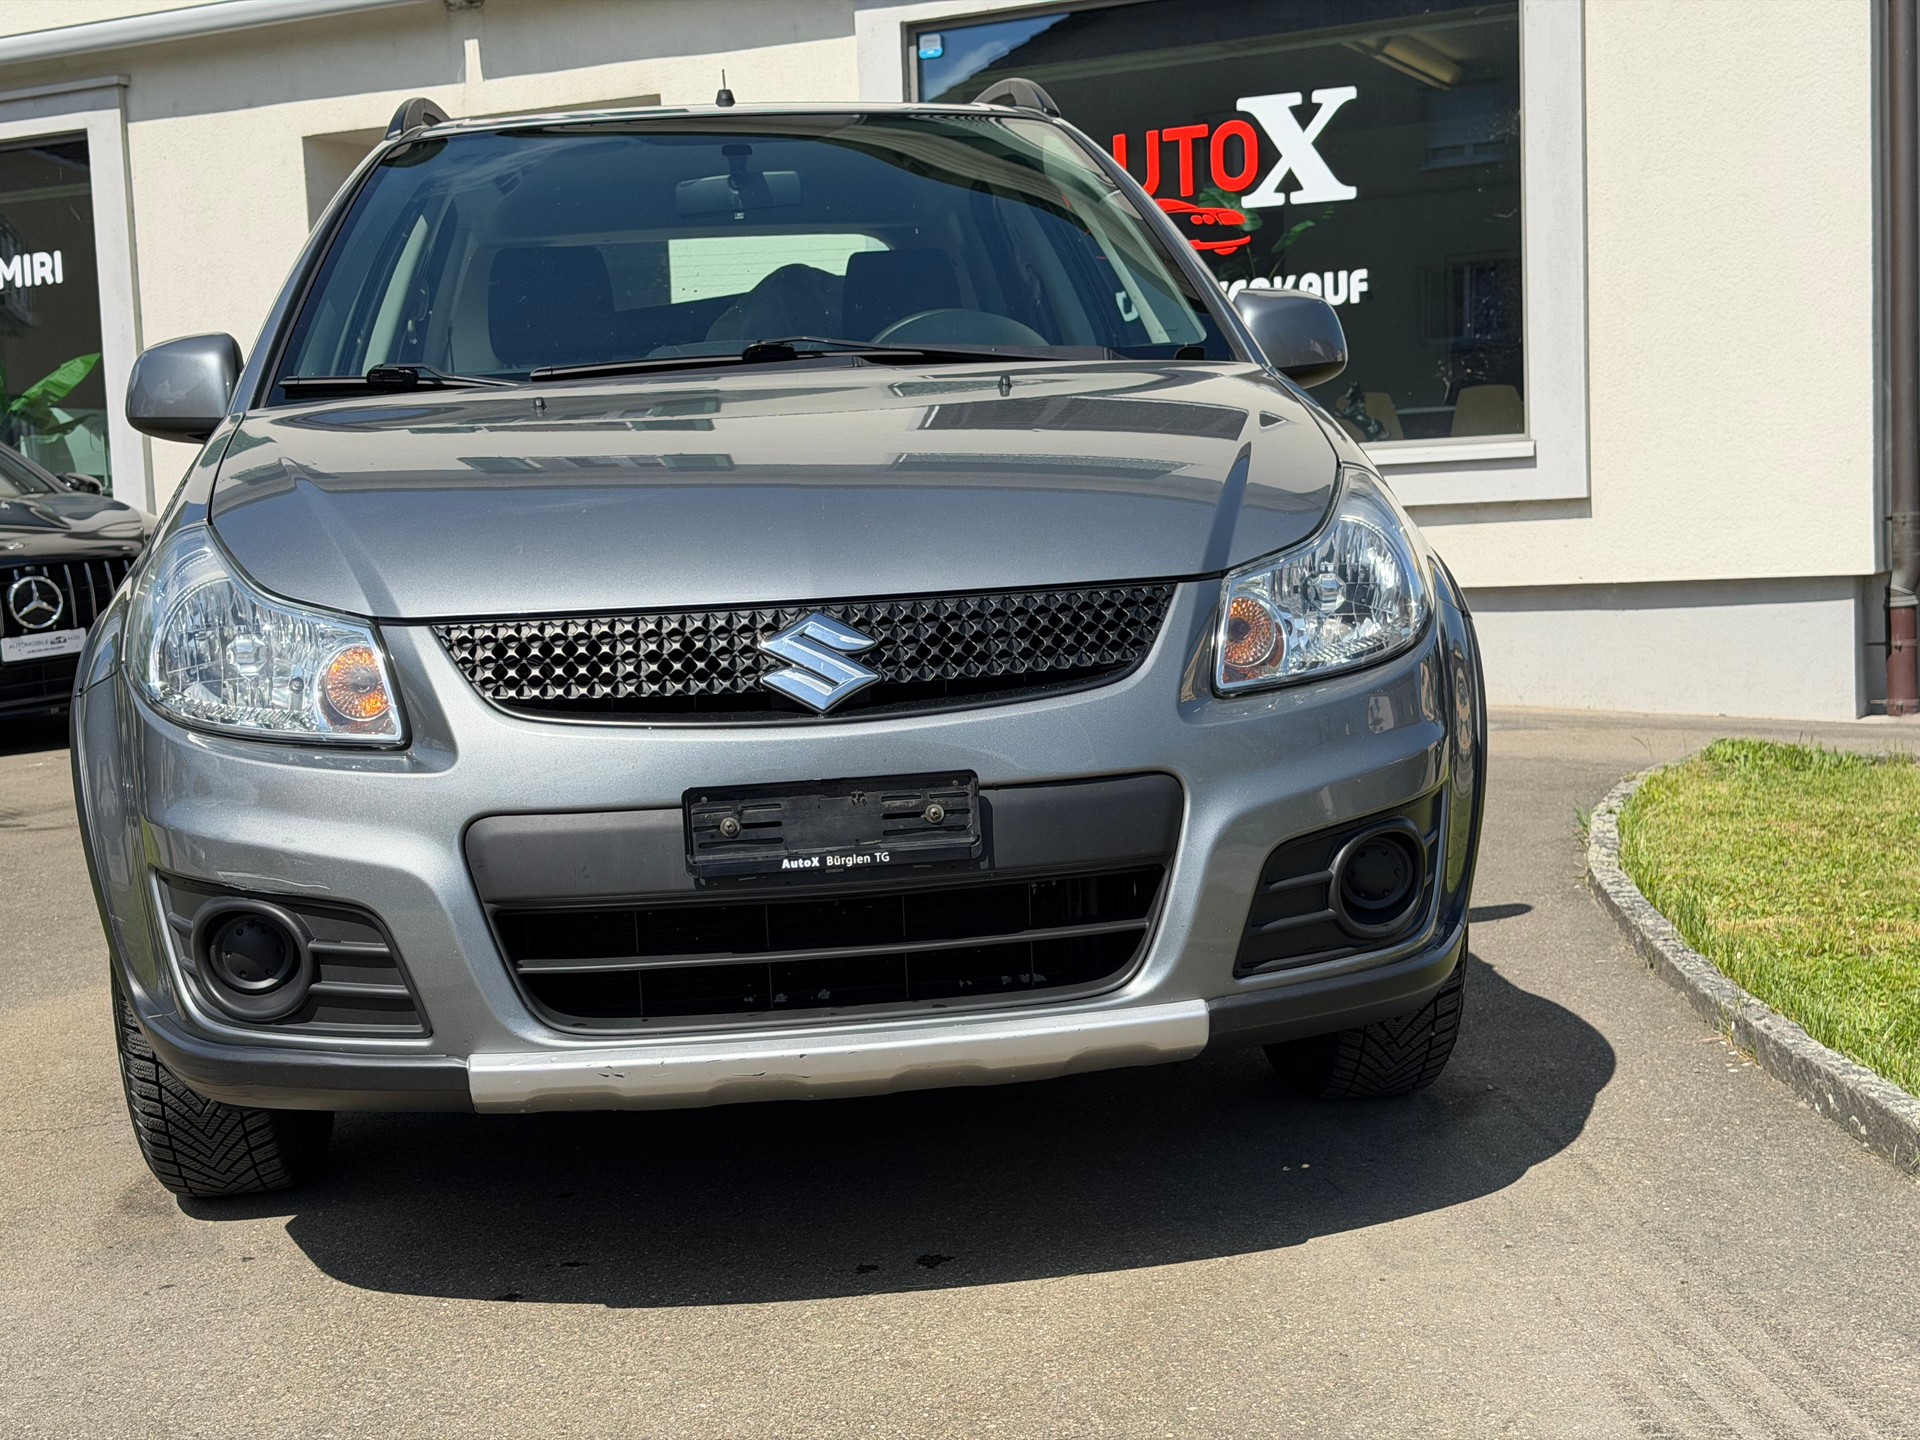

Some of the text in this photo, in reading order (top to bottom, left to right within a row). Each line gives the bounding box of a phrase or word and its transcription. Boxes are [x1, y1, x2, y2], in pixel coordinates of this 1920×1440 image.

[1112, 85, 1357, 209] UTOX
[781, 852, 890, 869] AutoX Bürglen TG
